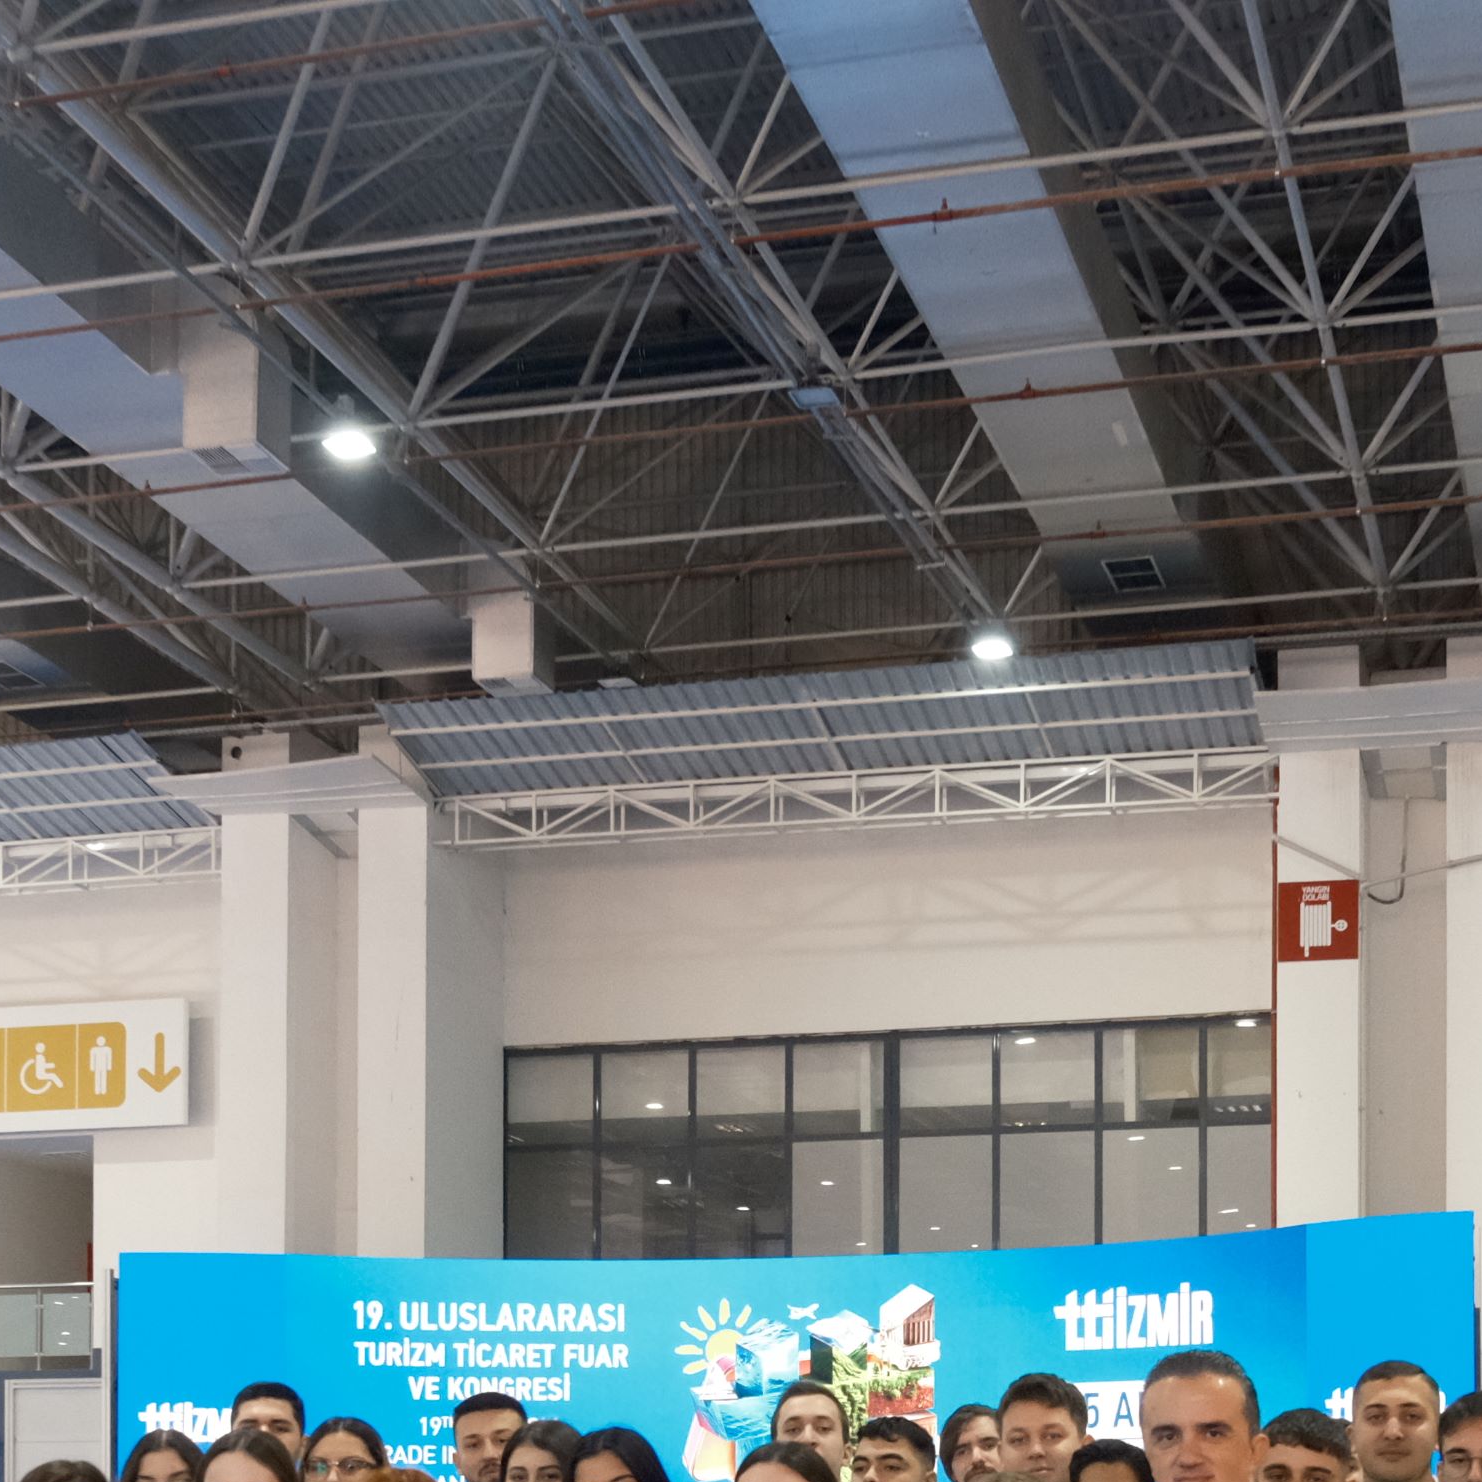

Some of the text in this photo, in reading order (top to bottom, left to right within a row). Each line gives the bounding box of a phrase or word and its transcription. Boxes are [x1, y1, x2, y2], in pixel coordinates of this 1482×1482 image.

[1302, 886, 1330, 894] YANGIN
[353, 1300, 626, 1333] 19. ULUSLARARASI
[354, 1337, 629, 1369] TURİZM TİCARET FUAR
[408, 1372, 571, 1402] VE KONGRESİ
[384, 1445, 438, 1465] RADE
